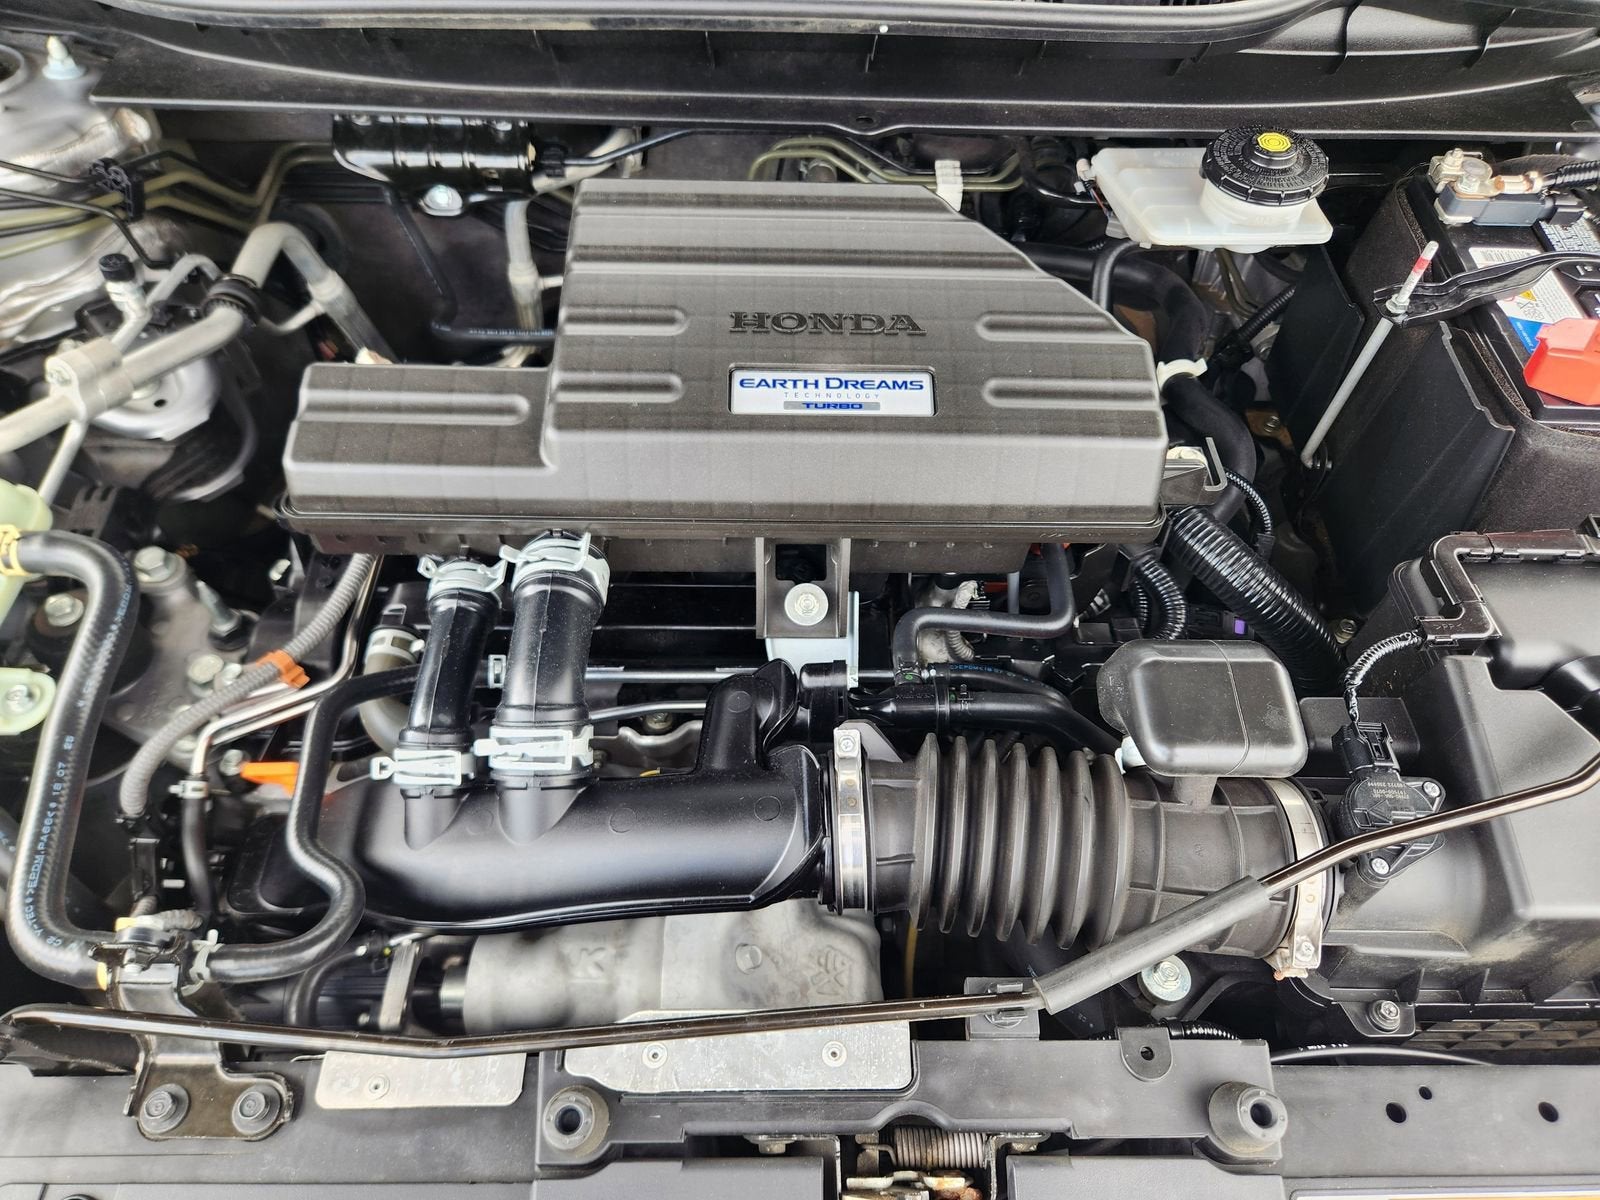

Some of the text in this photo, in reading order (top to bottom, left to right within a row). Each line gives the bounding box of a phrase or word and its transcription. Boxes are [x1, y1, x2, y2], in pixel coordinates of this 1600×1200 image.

[729, 311, 927, 336] HONDA
[739, 377, 924, 390] EARTH DREAMS
[784, 391, 880, 399] TECHNOLOGY
[801, 402, 863, 410] TURBO
